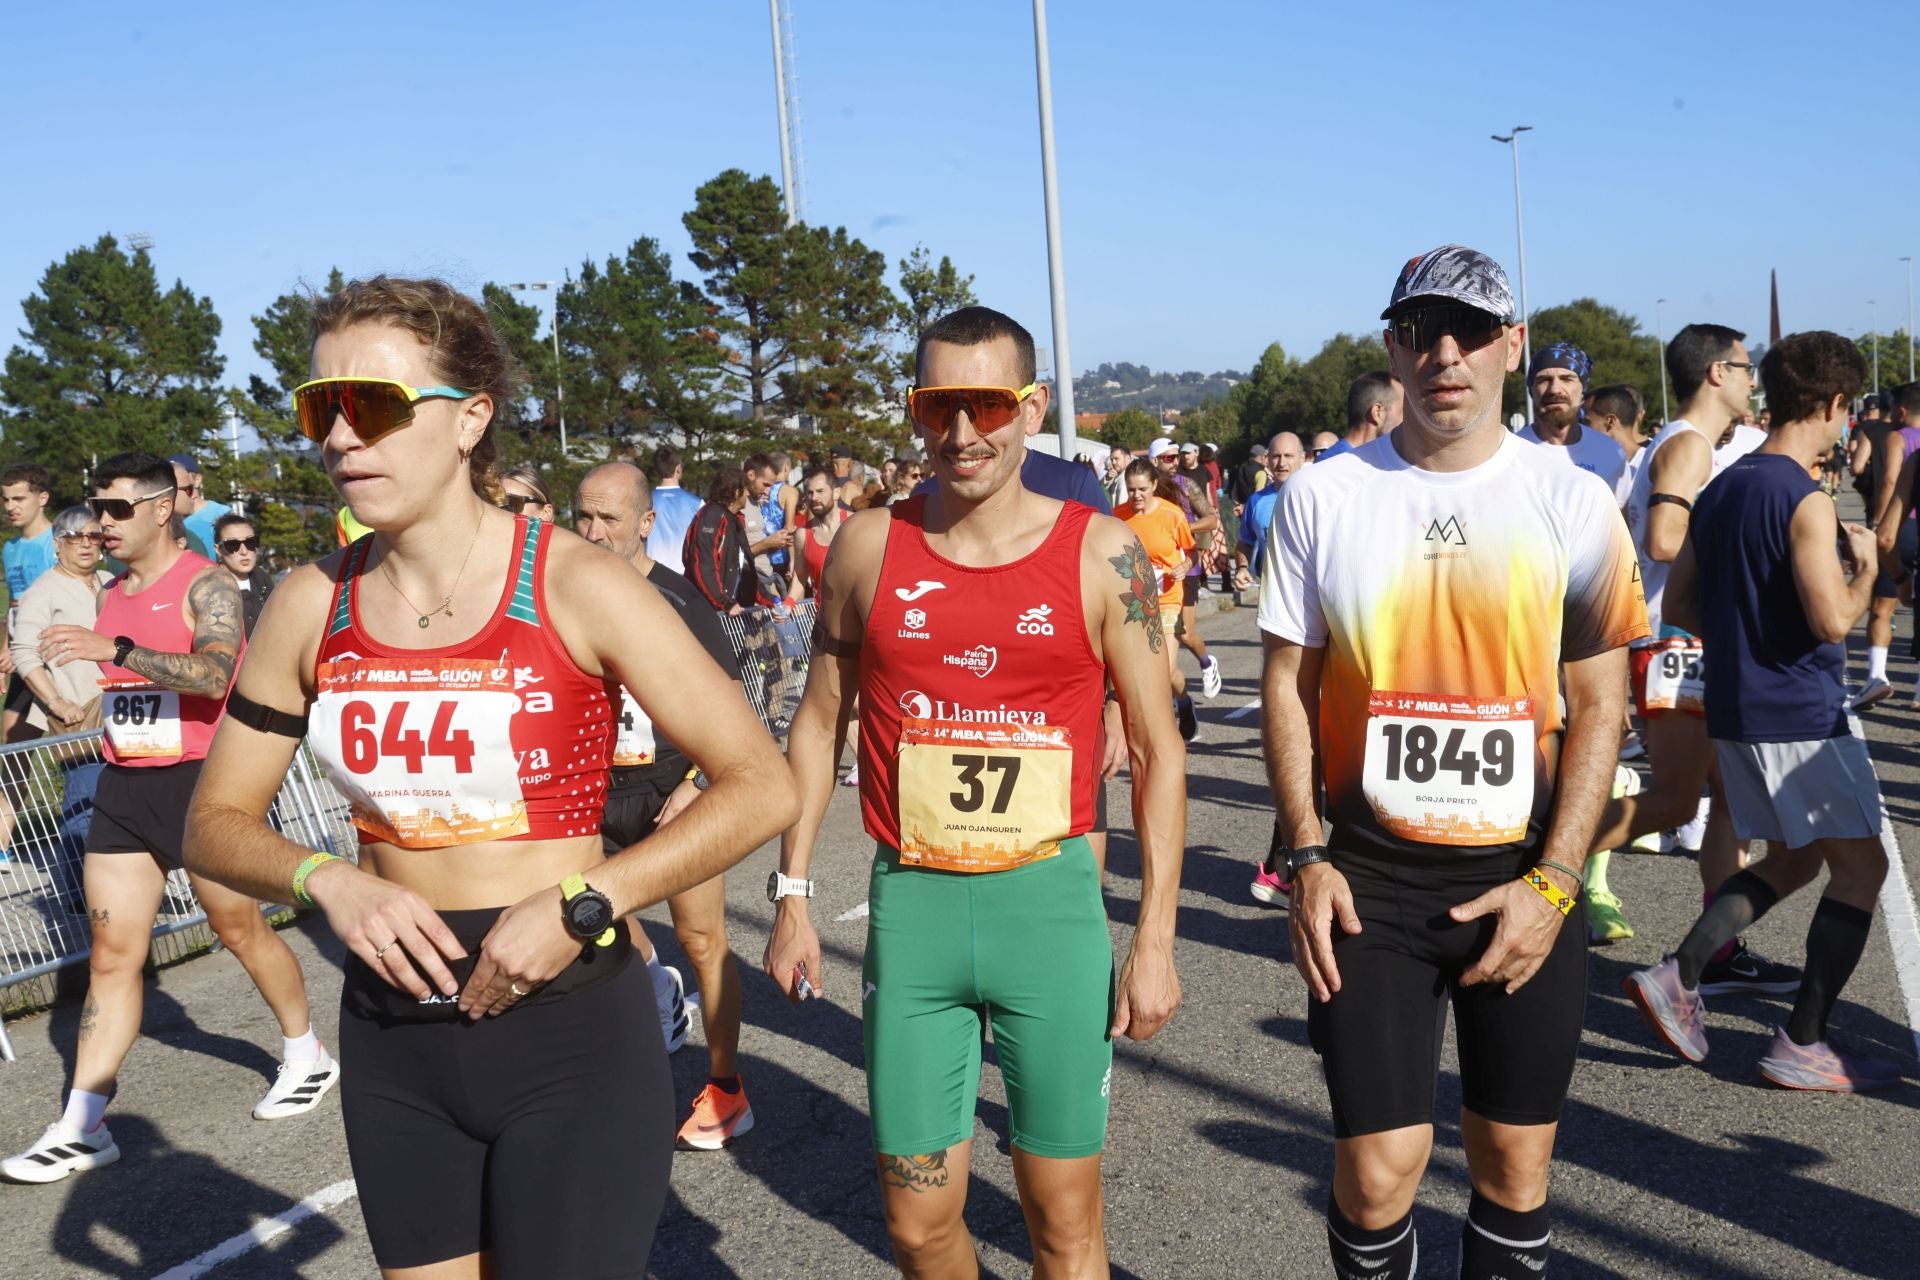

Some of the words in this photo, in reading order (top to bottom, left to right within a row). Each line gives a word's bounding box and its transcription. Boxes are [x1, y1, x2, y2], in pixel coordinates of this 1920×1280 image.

[898, 629, 930, 639] Llanes
[943, 655, 988, 667] Hispana
[964, 650, 988, 659] Patria
[1663, 652, 1705, 681] 95
[366, 669, 408, 683] MBA
[439, 668, 483, 683] GIJÓN
[112, 695, 162, 726] 867
[1415, 700, 1449, 713] MBA
[1476, 702, 1510, 715] GIJÓN
[340, 700, 476, 775] 644
[951, 728, 985, 741] MBA
[1012, 731, 1047, 743] GIJÓN
[1382, 723, 1515, 787] 1849
[519, 773, 552, 785] rupo
[949, 754, 1021, 814] 37
[368, 788, 410, 798] MARINA
[412, 789, 452, 797] GUERRA
[1416, 795, 1445, 804] BORJA
[1446, 796, 1478, 805] PRIETO
[944, 824, 967, 832] JUAN
[968, 825, 1022, 834] OJANGUREN
